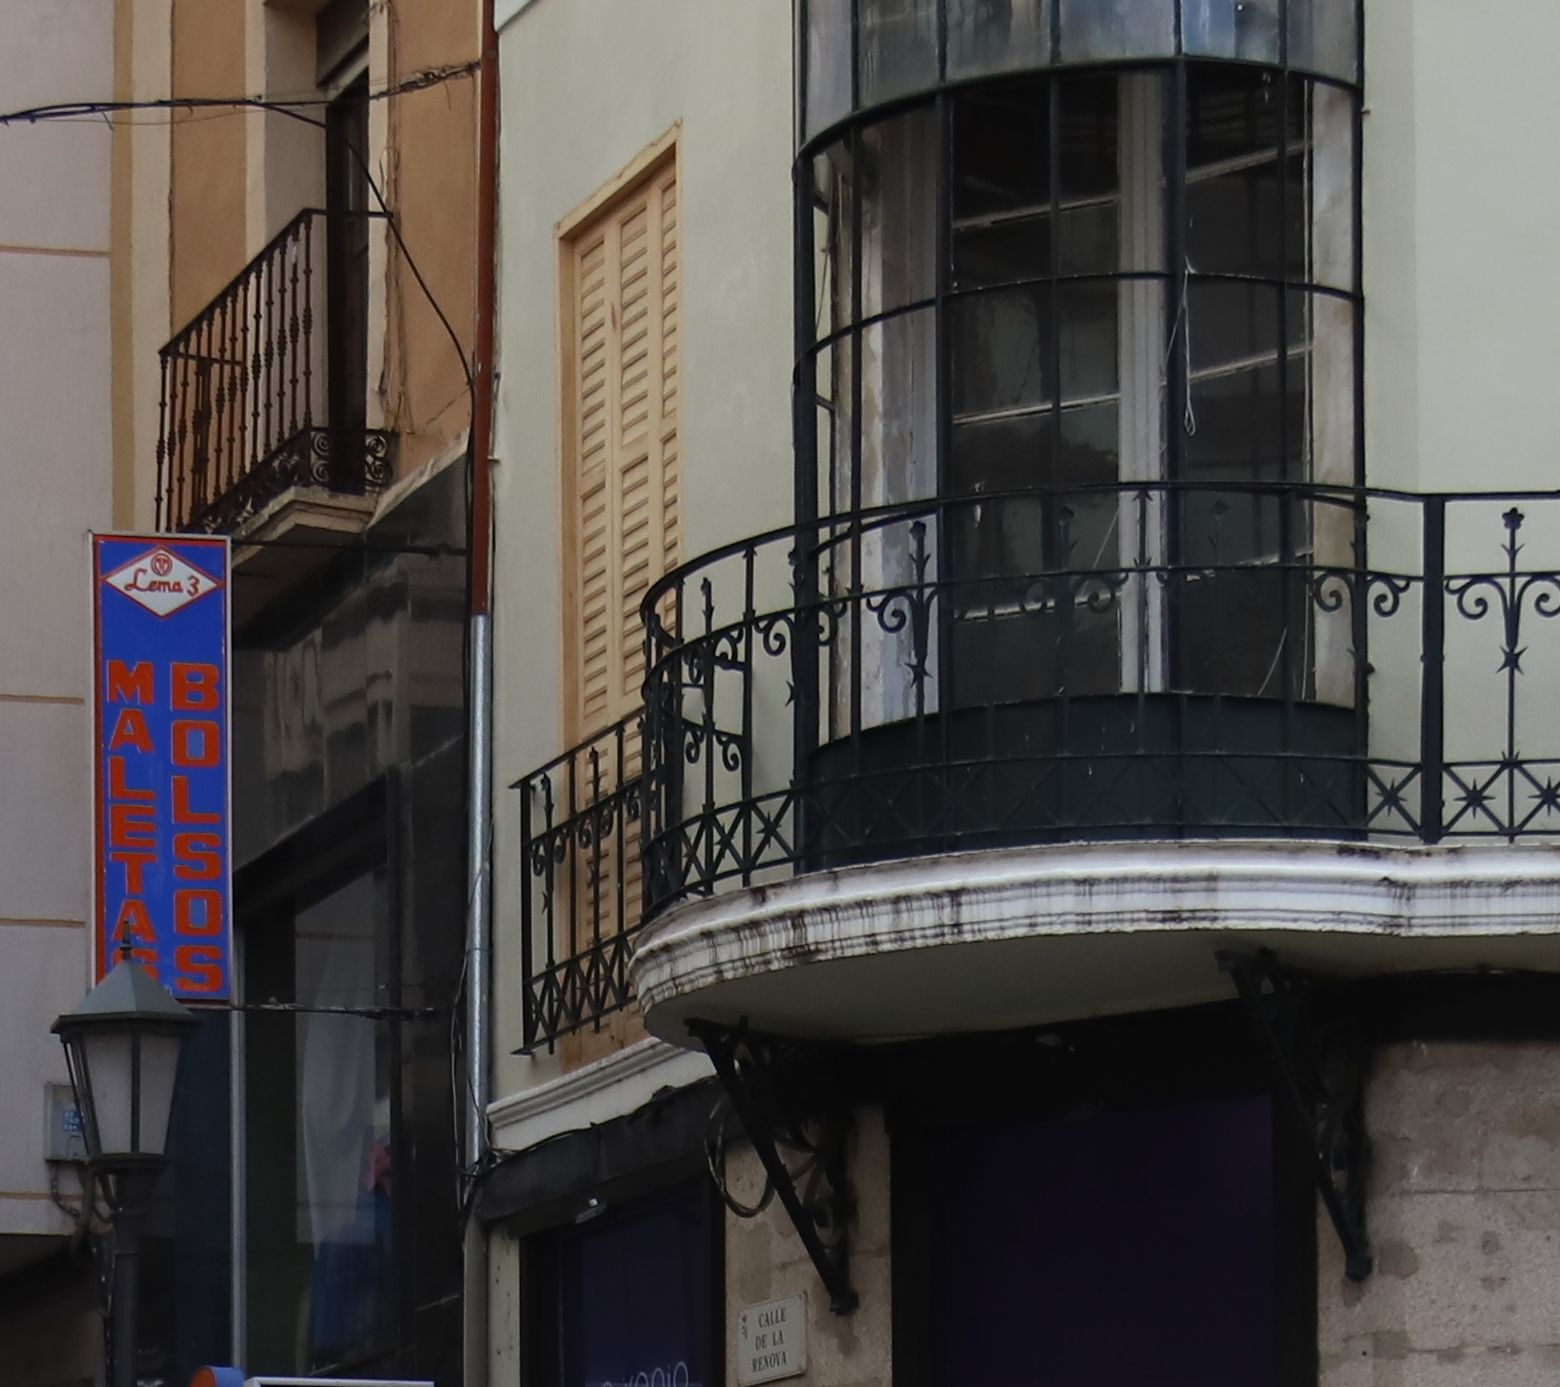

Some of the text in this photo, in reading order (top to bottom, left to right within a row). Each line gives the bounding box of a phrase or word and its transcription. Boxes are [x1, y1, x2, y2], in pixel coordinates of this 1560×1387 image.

[124, 566, 200, 597] Lema 3
[170, 661, 224, 993] BOLSOS
[758, 1306, 787, 1329] CALLE
[754, 1329, 785, 1351] DE LA
[751, 1351, 788, 1373] RENOVA
